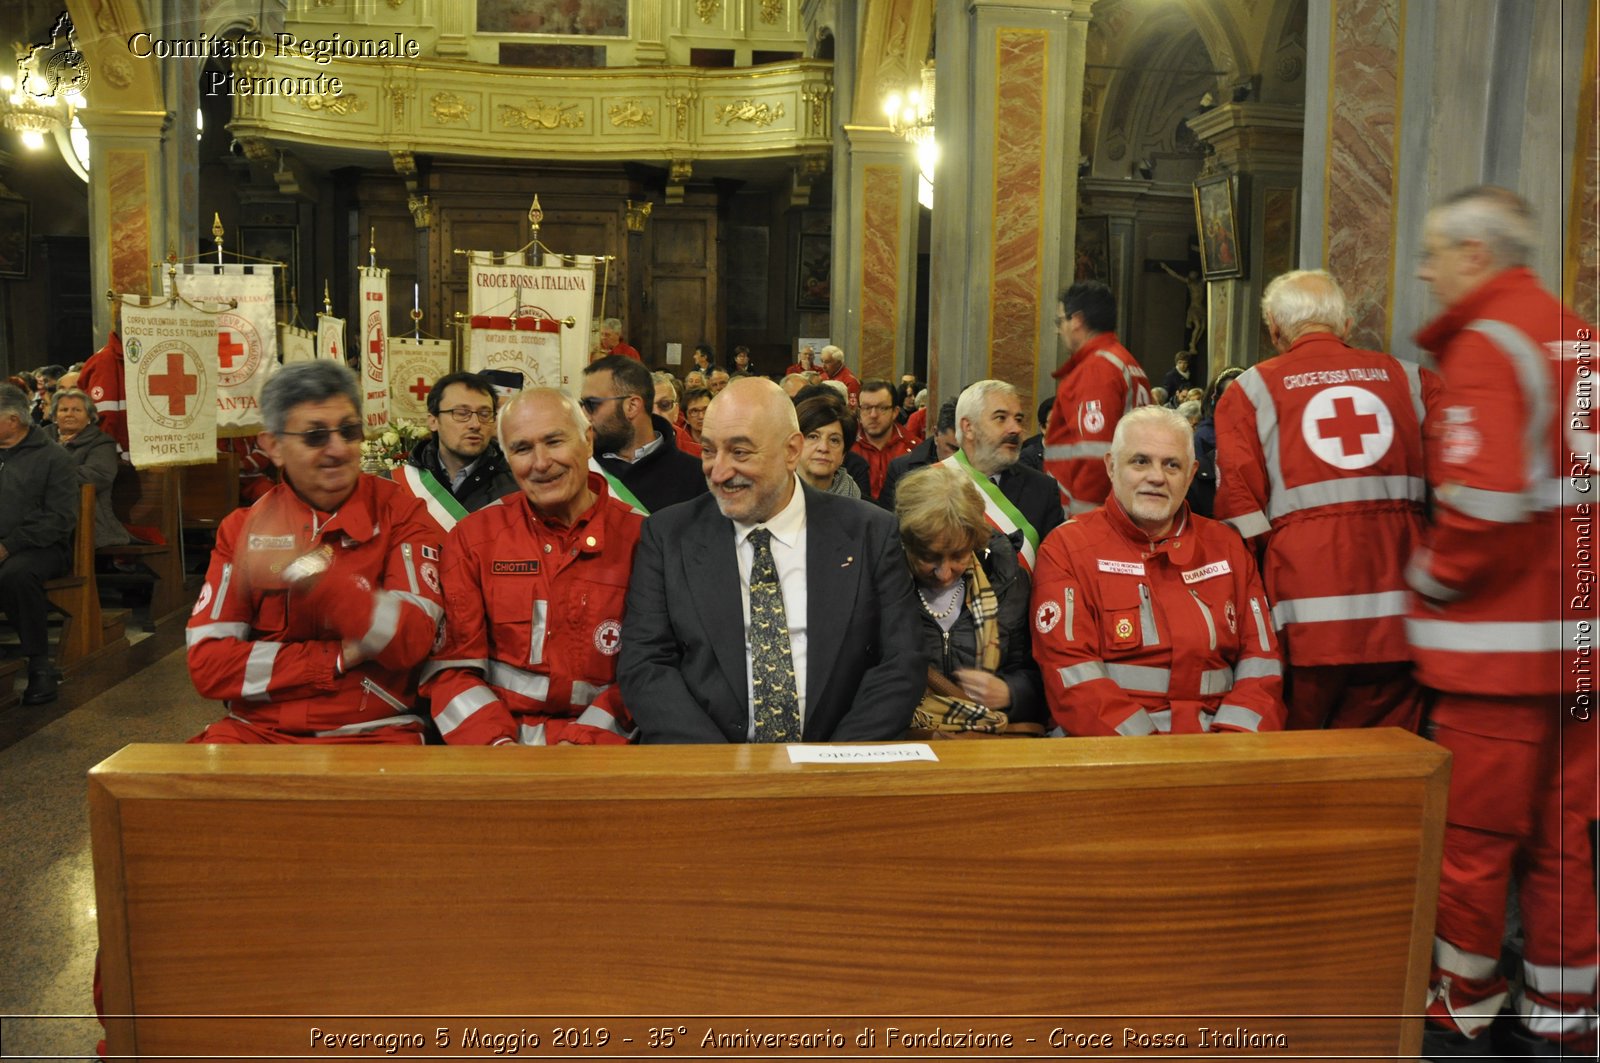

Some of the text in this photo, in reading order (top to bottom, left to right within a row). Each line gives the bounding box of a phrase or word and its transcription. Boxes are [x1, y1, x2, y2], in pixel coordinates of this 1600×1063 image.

[477, 272, 586, 291] CROCE ROSSA ITALIANA
[124, 326, 218, 338] CROCE ROSSA ITALIANA
[487, 350, 524, 366] ROSSA
[1283, 368, 1390, 390] CROCE ROSSA ITALIANA
[216, 396, 258, 410] ANTA
[143, 434, 183, 442] COMITATO
[151, 442, 200, 454] MORETTA
[494, 562, 528, 571] CHIOTTI
[1184, 565, 1219, 581] DURANDO
[818, 750, 921, 758] Riservato
